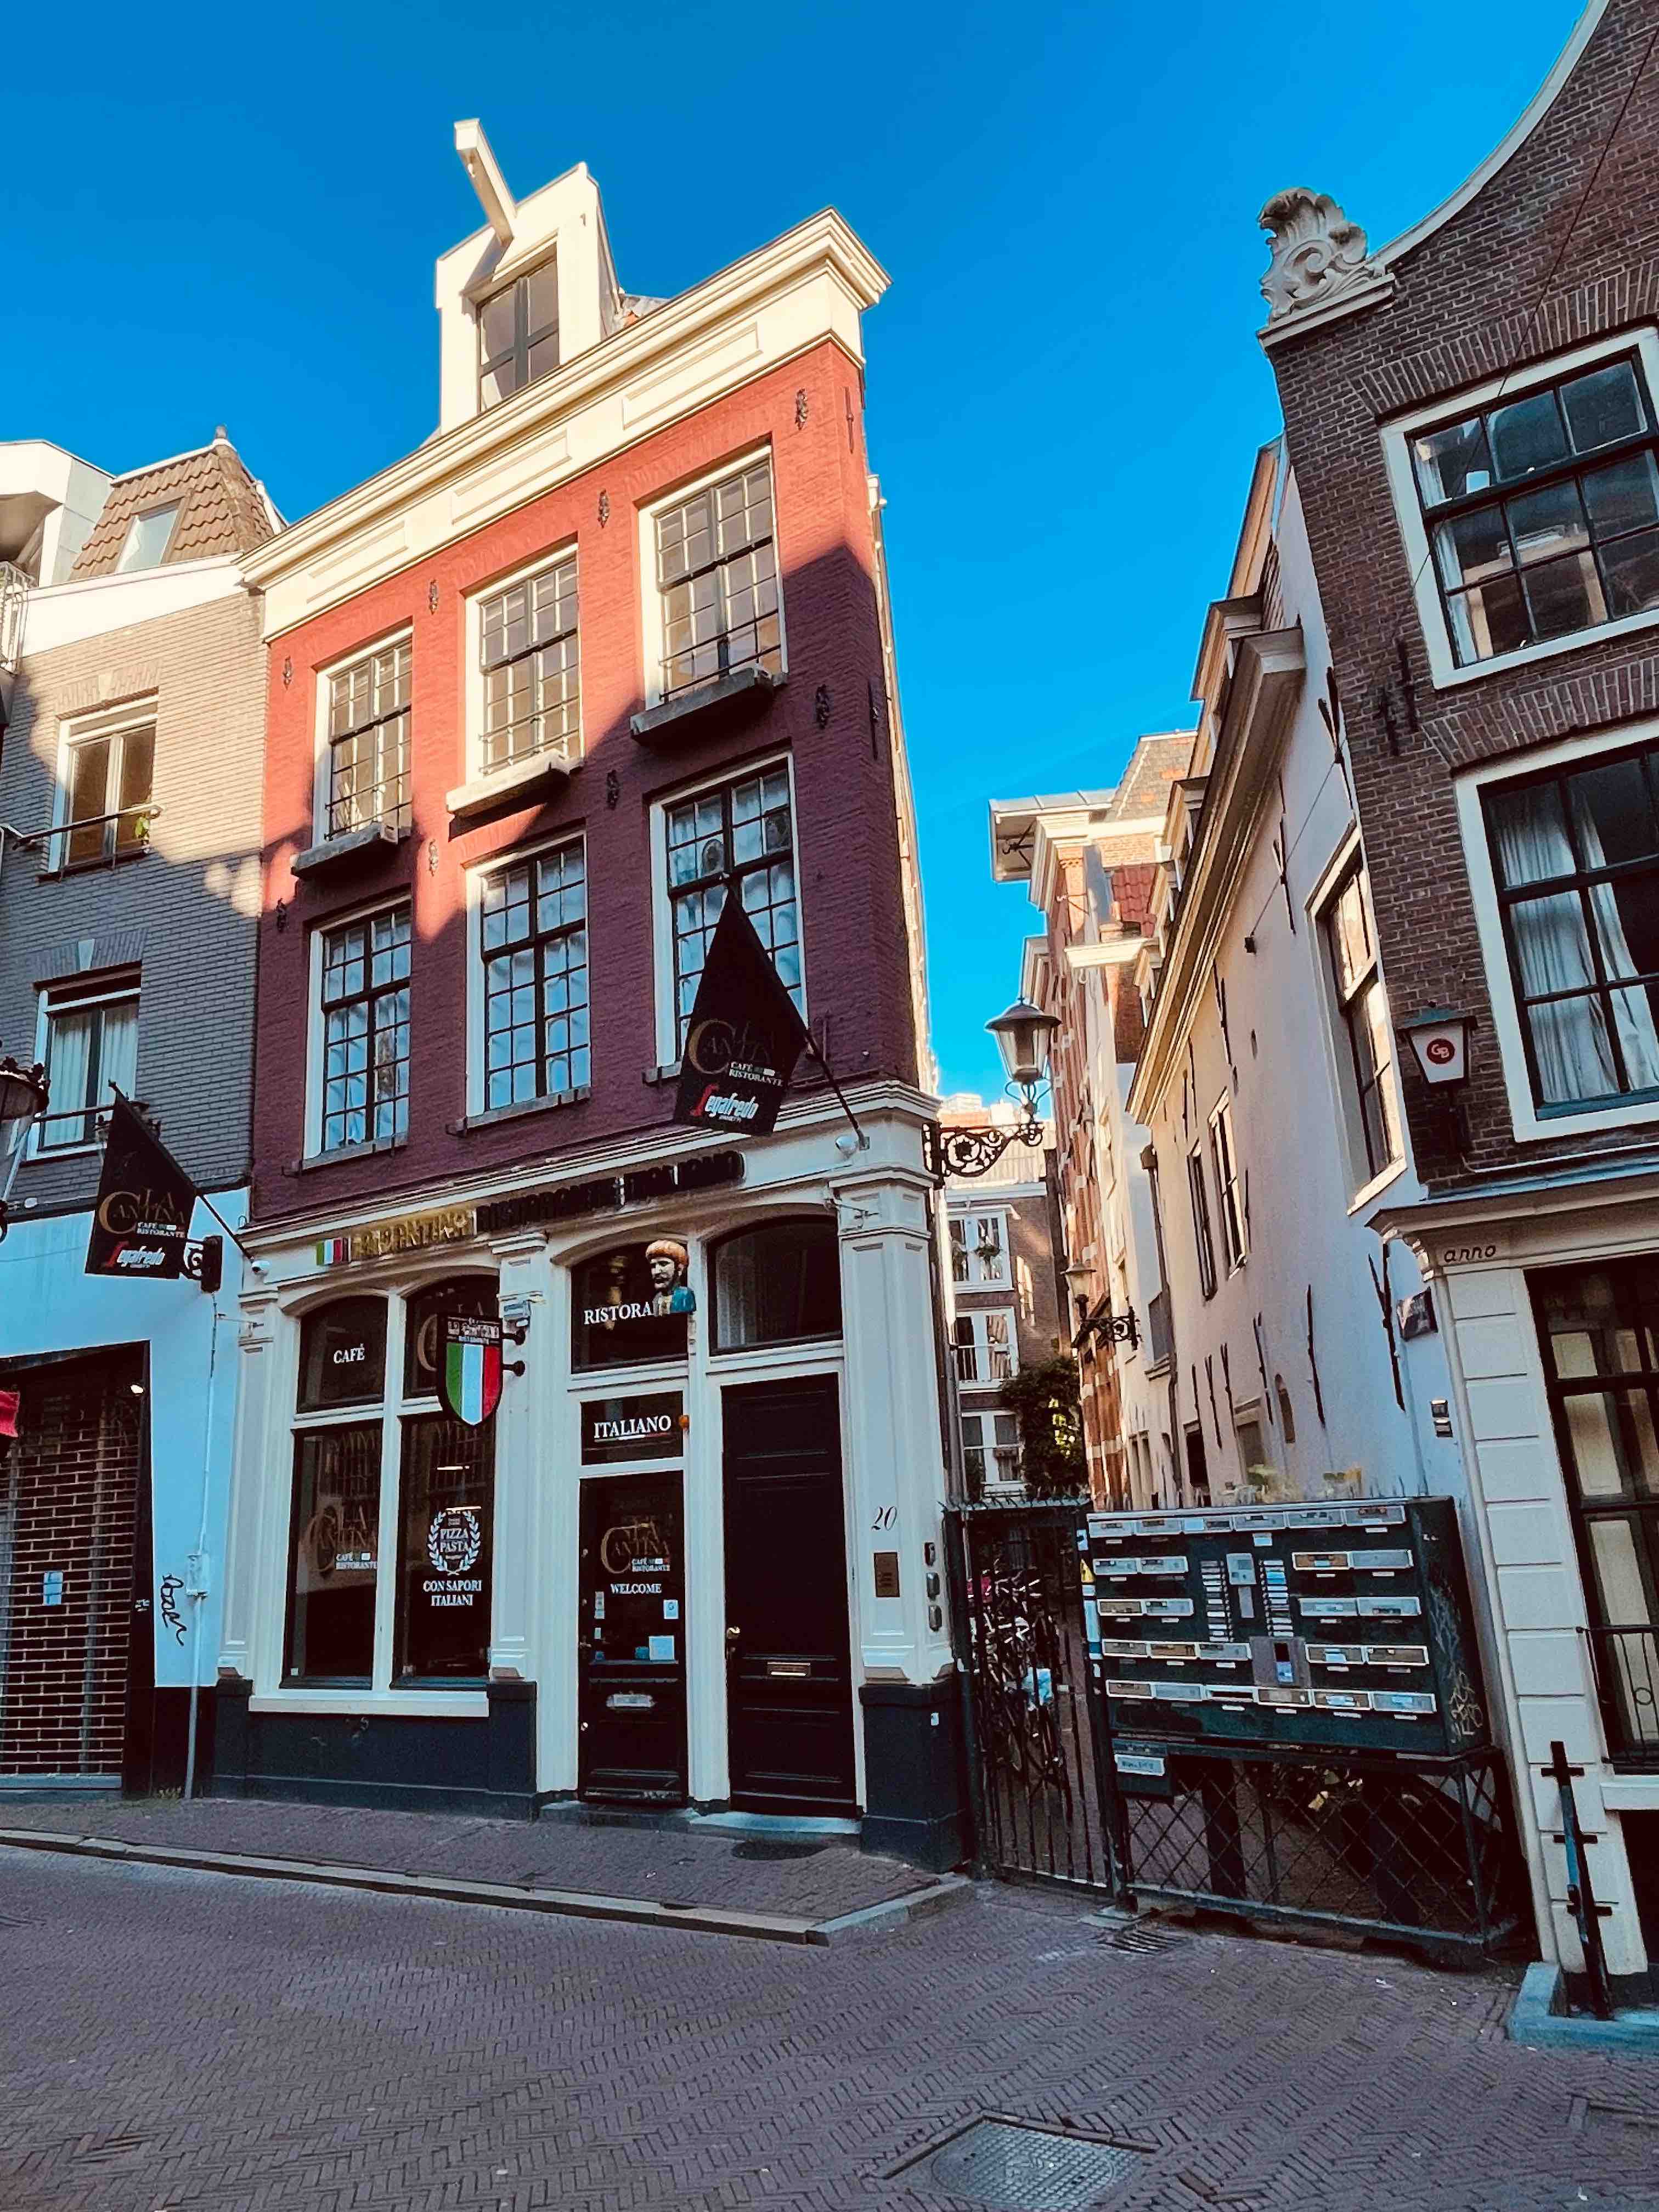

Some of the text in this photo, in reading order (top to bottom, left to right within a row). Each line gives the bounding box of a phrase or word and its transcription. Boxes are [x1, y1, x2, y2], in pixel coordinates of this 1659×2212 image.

[1444, 1245, 1496, 1262] anno
[584, 1301, 654, 1324] RISTORA
[333, 1342, 365, 1364] CAFÉ
[594, 1414, 672, 1438] ITALIANO
[871, 1505, 898, 1531] 20
[440, 1528, 469, 1540] PIZZA
[440, 1541, 469, 1553] PASTA
[423, 1580, 482, 1592] CON SAPORI
[610, 1583, 663, 1594] WELCOME
